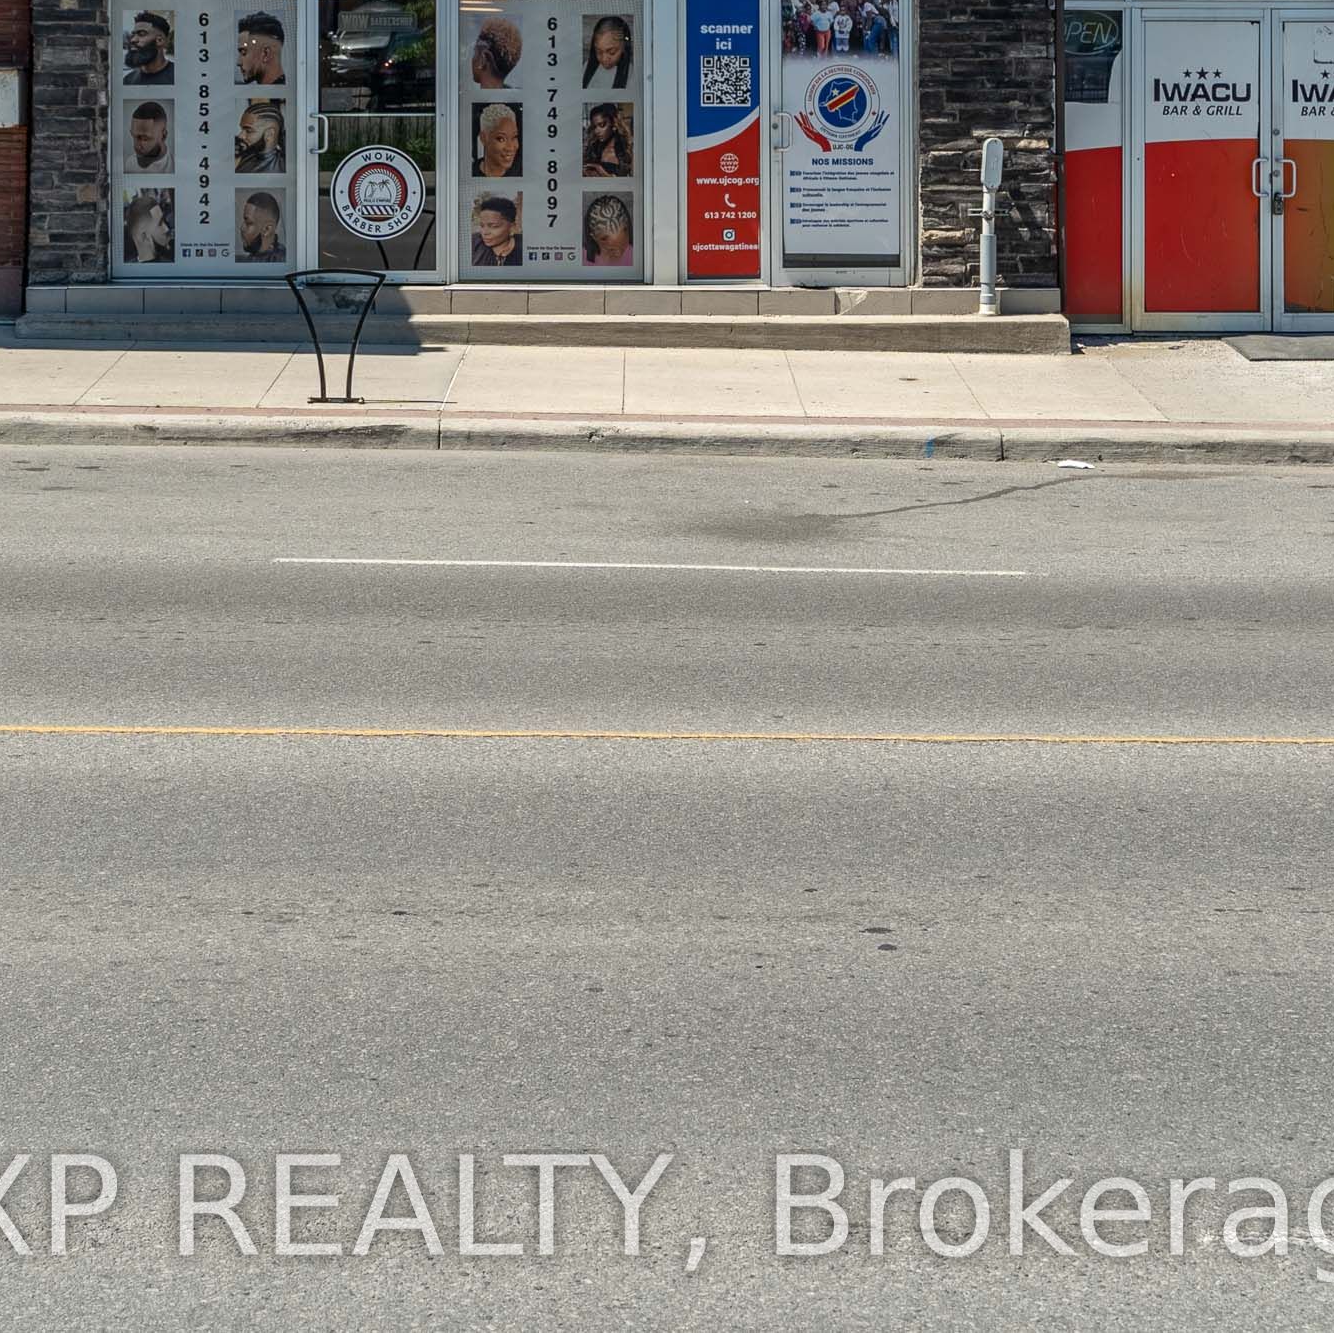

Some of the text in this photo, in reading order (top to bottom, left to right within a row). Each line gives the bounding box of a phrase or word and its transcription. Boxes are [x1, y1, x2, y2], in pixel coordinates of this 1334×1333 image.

[700, 23, 754, 35] scanner
[715, 38, 732, 50] ici
[1154, 78, 1252, 102] IWACU
[1162, 105, 1243, 116] BAR & GRILL
[1300, 106, 1327, 117] BAR
[361, 152, 396, 163] WOW
[811, 158, 874, 166] NOS MISSIONS
[696, 176, 760, 186] www.ujcog.org
[342, 205, 413, 233] BARBER SHOP
[704, 211, 757, 219] 613 742 1200
